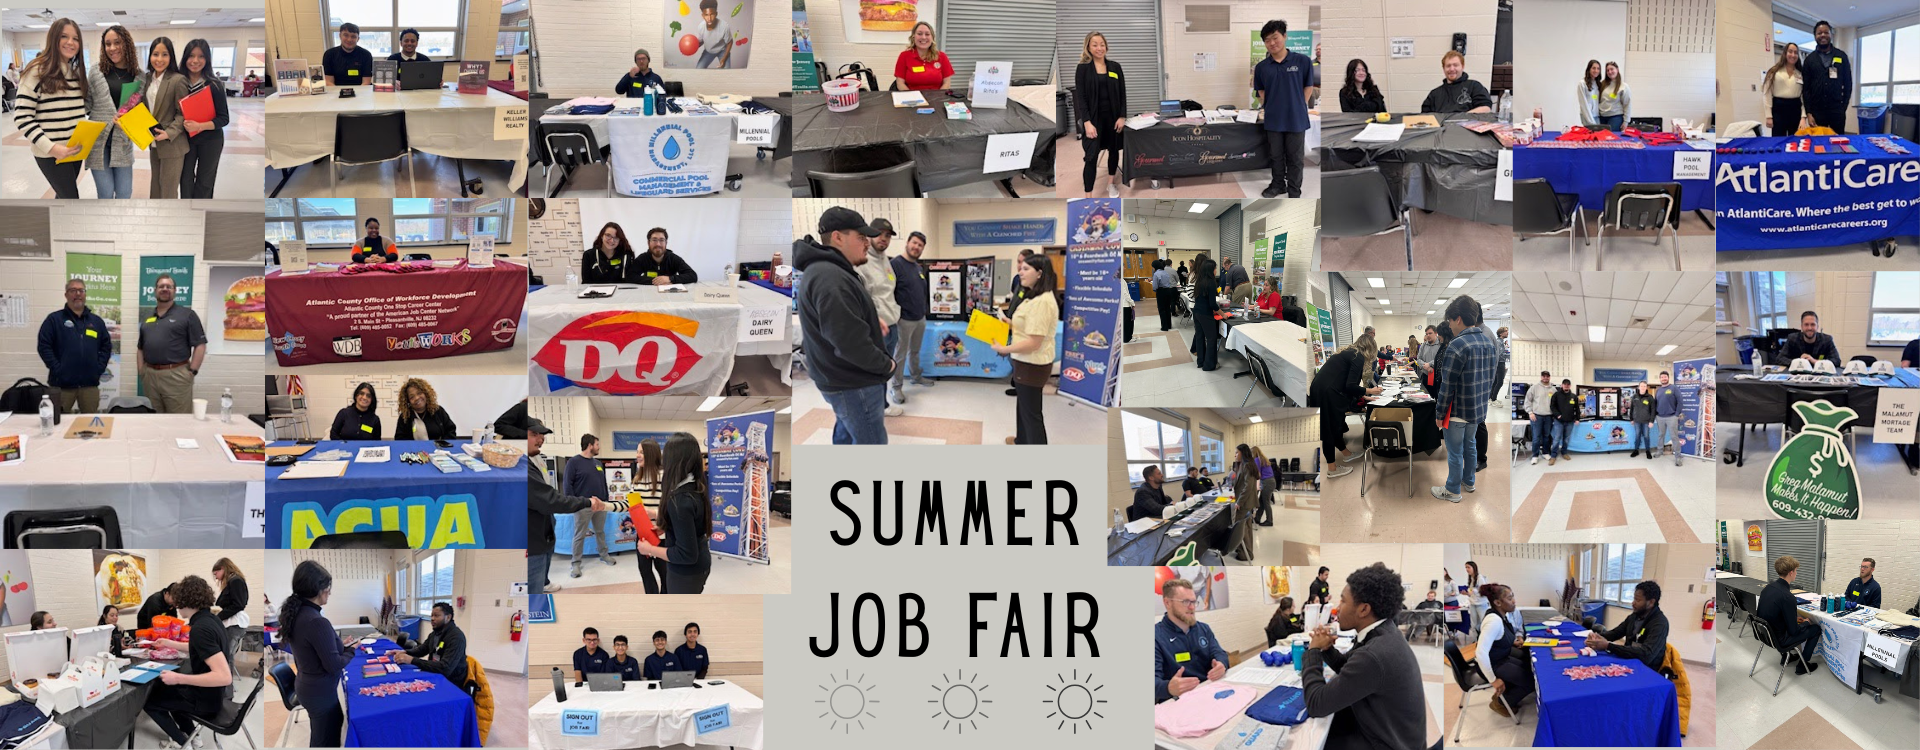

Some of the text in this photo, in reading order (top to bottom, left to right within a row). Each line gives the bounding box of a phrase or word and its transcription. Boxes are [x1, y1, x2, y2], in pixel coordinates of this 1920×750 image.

[650, 124, 695, 148] MILLENNIAL POOL
[633, 176, 686, 184] COMMERCIAL
[1716, 159, 1919, 193] AtlantiCare
[638, 182, 694, 190] MANAGEMENT
[675, 186, 712, 194] SERVICES
[1727, 208, 1794, 219] AtlantiCare.
[1796, 207, 1831, 217] Where
[1833, 205, 1850, 214] the
[1852, 201, 1874, 211] best
[1877, 200, 1894, 211] get
[1896, 199, 1907, 207] to
[1760, 219, 1888, 233] www.atlanticarecareers.org
[71, 273, 118, 283] JOURNEY
[143, 286, 190, 296] JOEY
[432, 290, 476, 300] Development
[333, 340, 362, 354] WDB
[560, 336, 678, 386] DQ
[1067, 370, 1080, 379] DQ
[1808, 451, 1824, 478] $
[1778, 471, 1849, 504] Greg Malamut
[1771, 483, 1858, 519] Makes It Happen!
[1772, 500, 1832, 520] 609-432-
[1867, 643, 1896, 659] MILLENNIAL
[1872, 652, 1888, 662] POOLS
